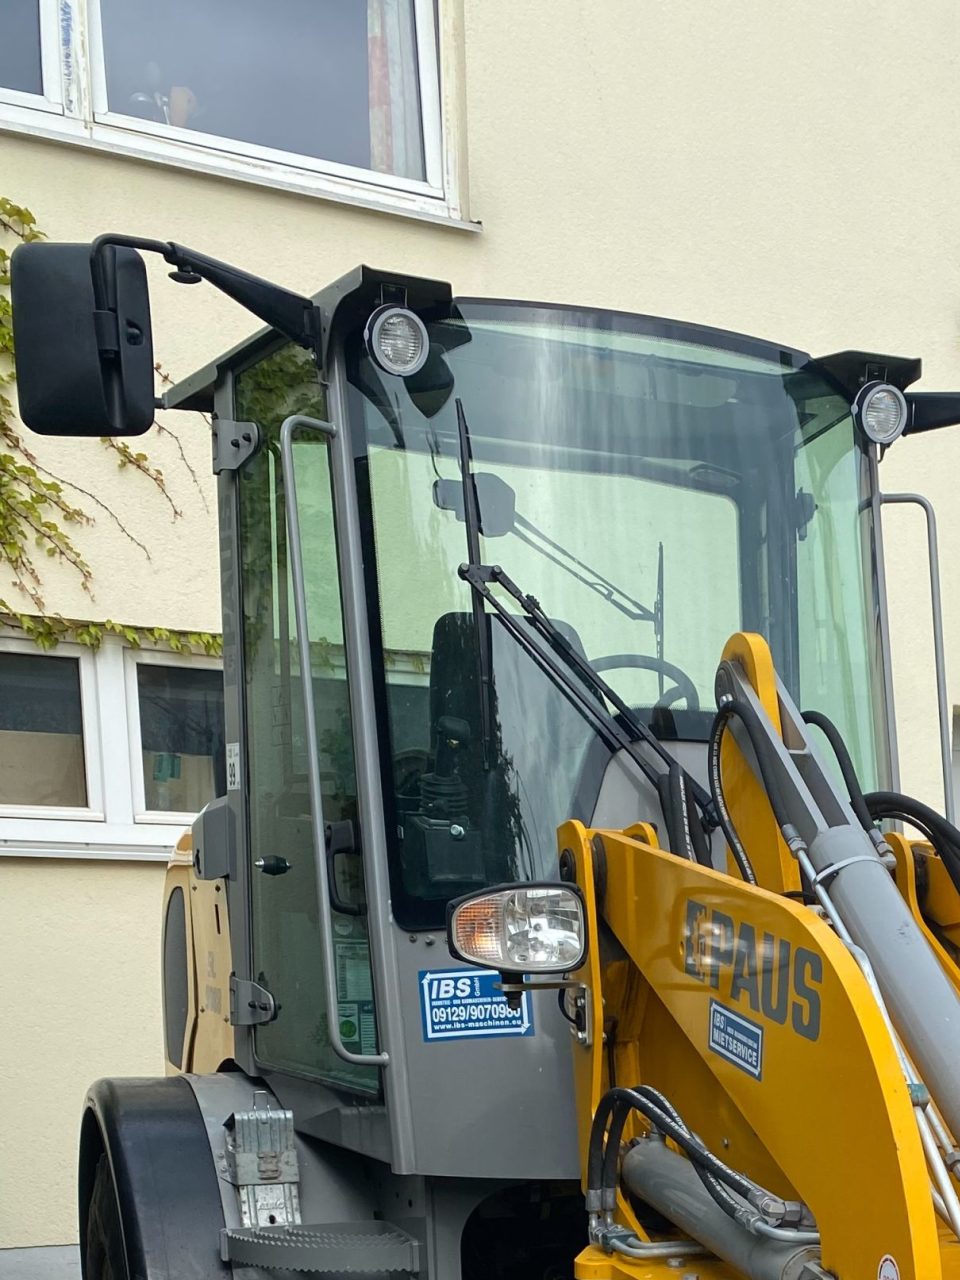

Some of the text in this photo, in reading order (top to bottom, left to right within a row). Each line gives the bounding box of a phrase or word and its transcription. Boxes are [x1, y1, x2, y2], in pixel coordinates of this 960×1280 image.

[431, 978, 471, 999] IBS
[713, 1011, 725, 1029] IBS
[712, 1028, 758, 1066] MIETSERVICE
